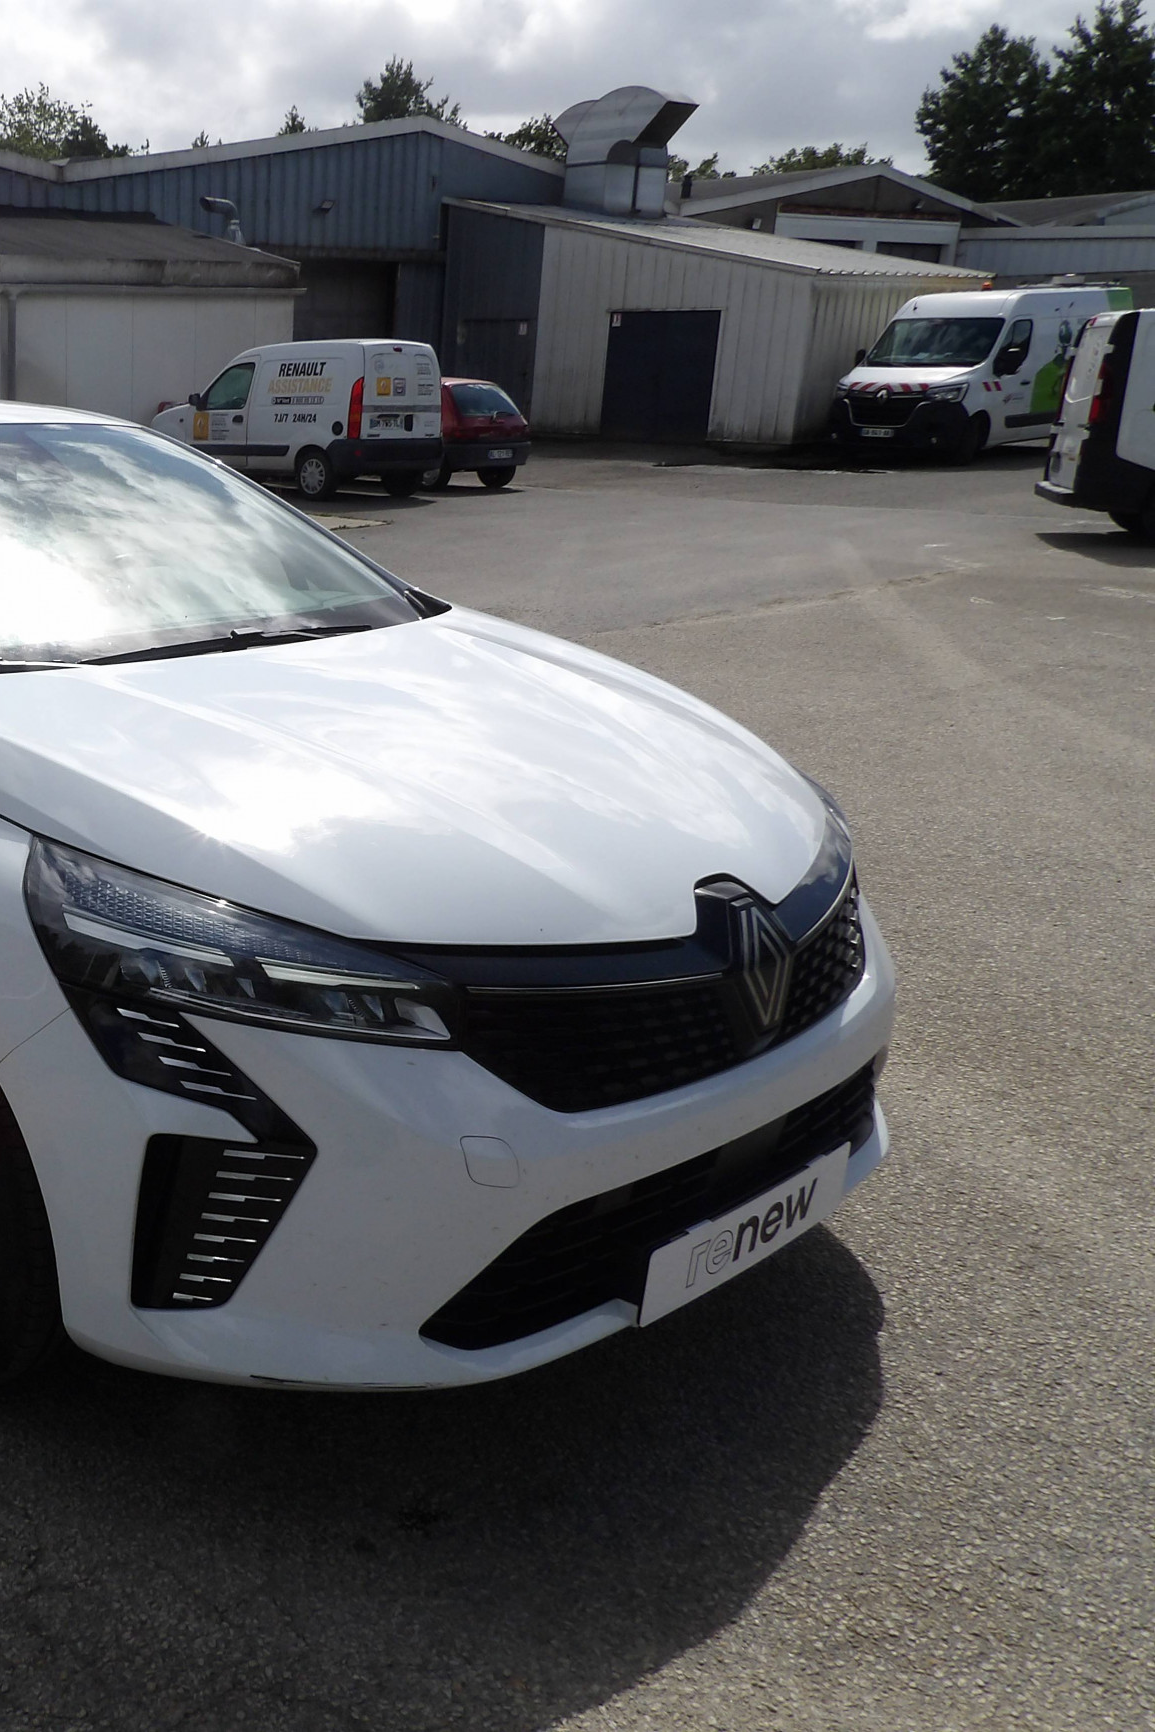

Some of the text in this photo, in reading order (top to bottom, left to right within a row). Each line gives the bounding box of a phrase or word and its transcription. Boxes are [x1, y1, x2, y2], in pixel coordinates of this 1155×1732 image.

[278, 362, 327, 377] RENAULT
[268, 377, 333, 394] ASSISTANCE
[292, 413, 317, 423] 24H/24
[685, 1177, 818, 1289] renew
